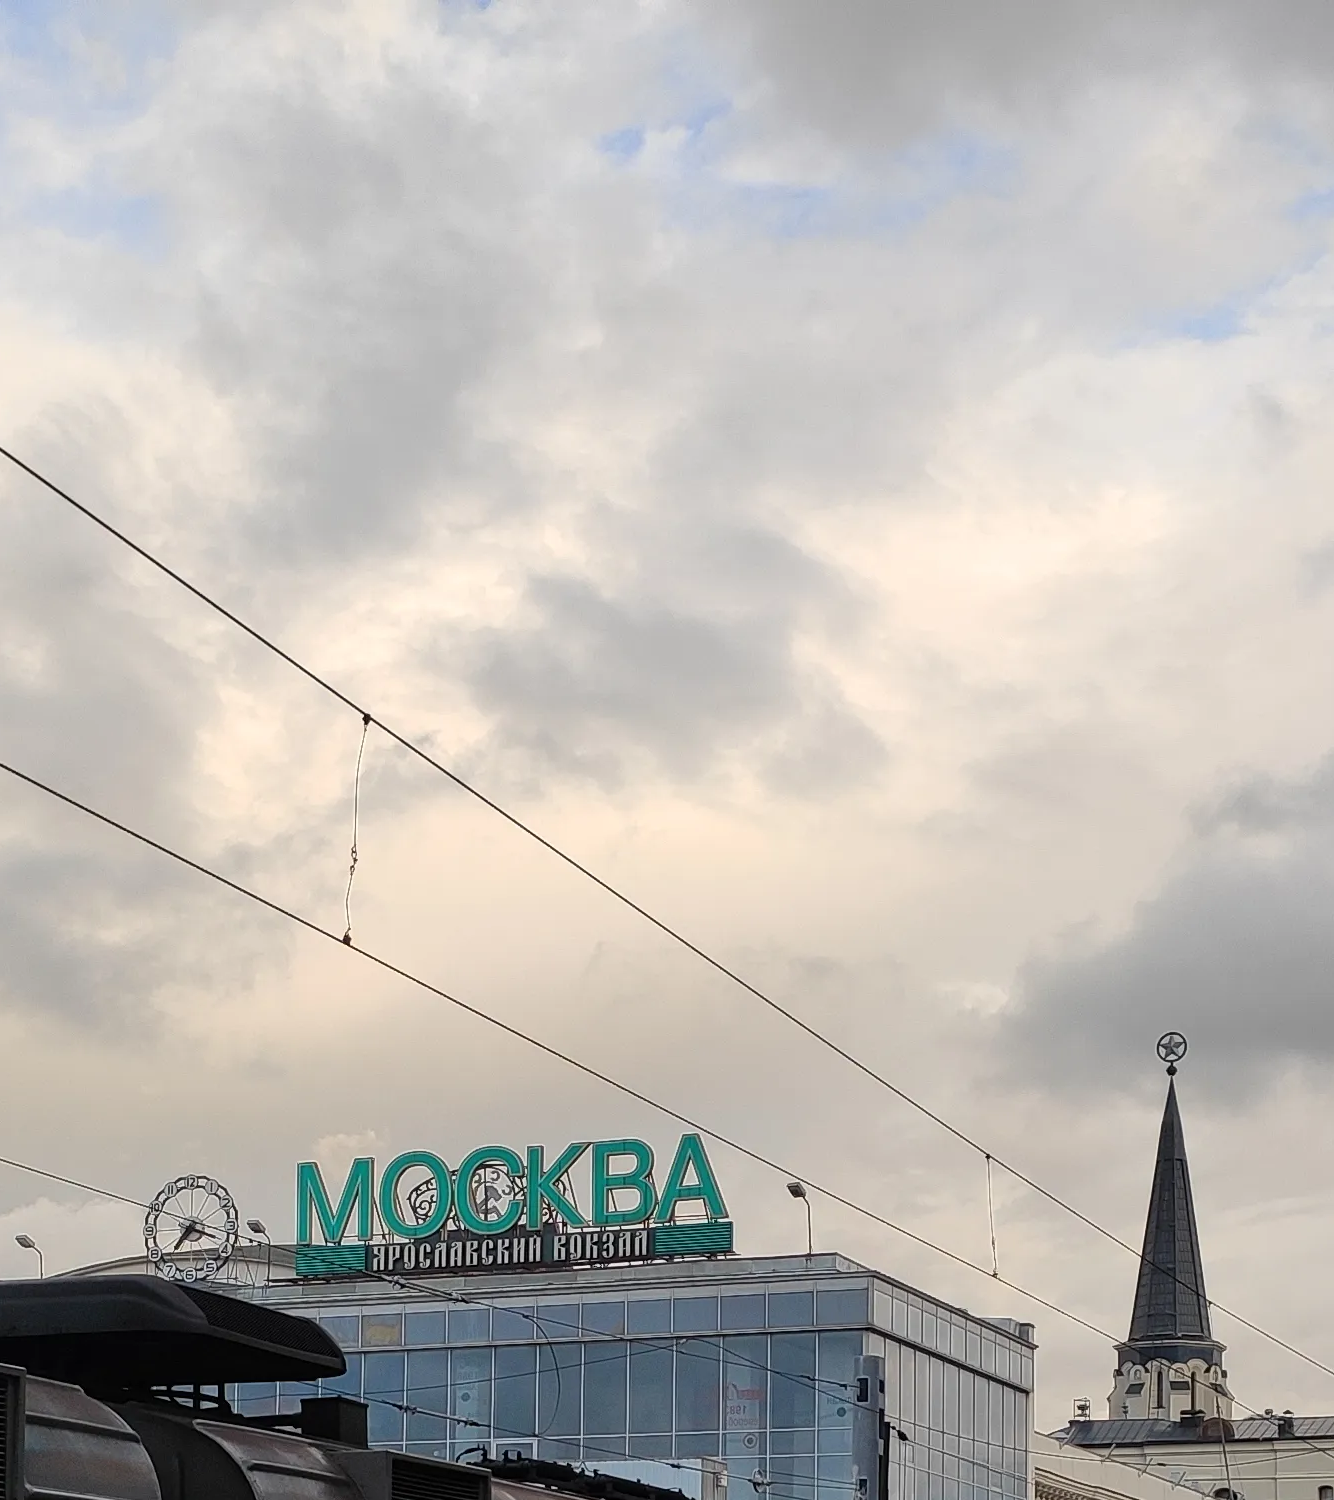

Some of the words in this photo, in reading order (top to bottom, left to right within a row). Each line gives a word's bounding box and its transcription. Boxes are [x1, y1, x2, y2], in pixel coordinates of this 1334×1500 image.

[297, 1133, 728, 1245] МОСКВА
[371, 1234, 542, 1272] ЯРОСЛАВСКИЙ
[553, 1230, 648, 1262] ВОКЗАЛ
